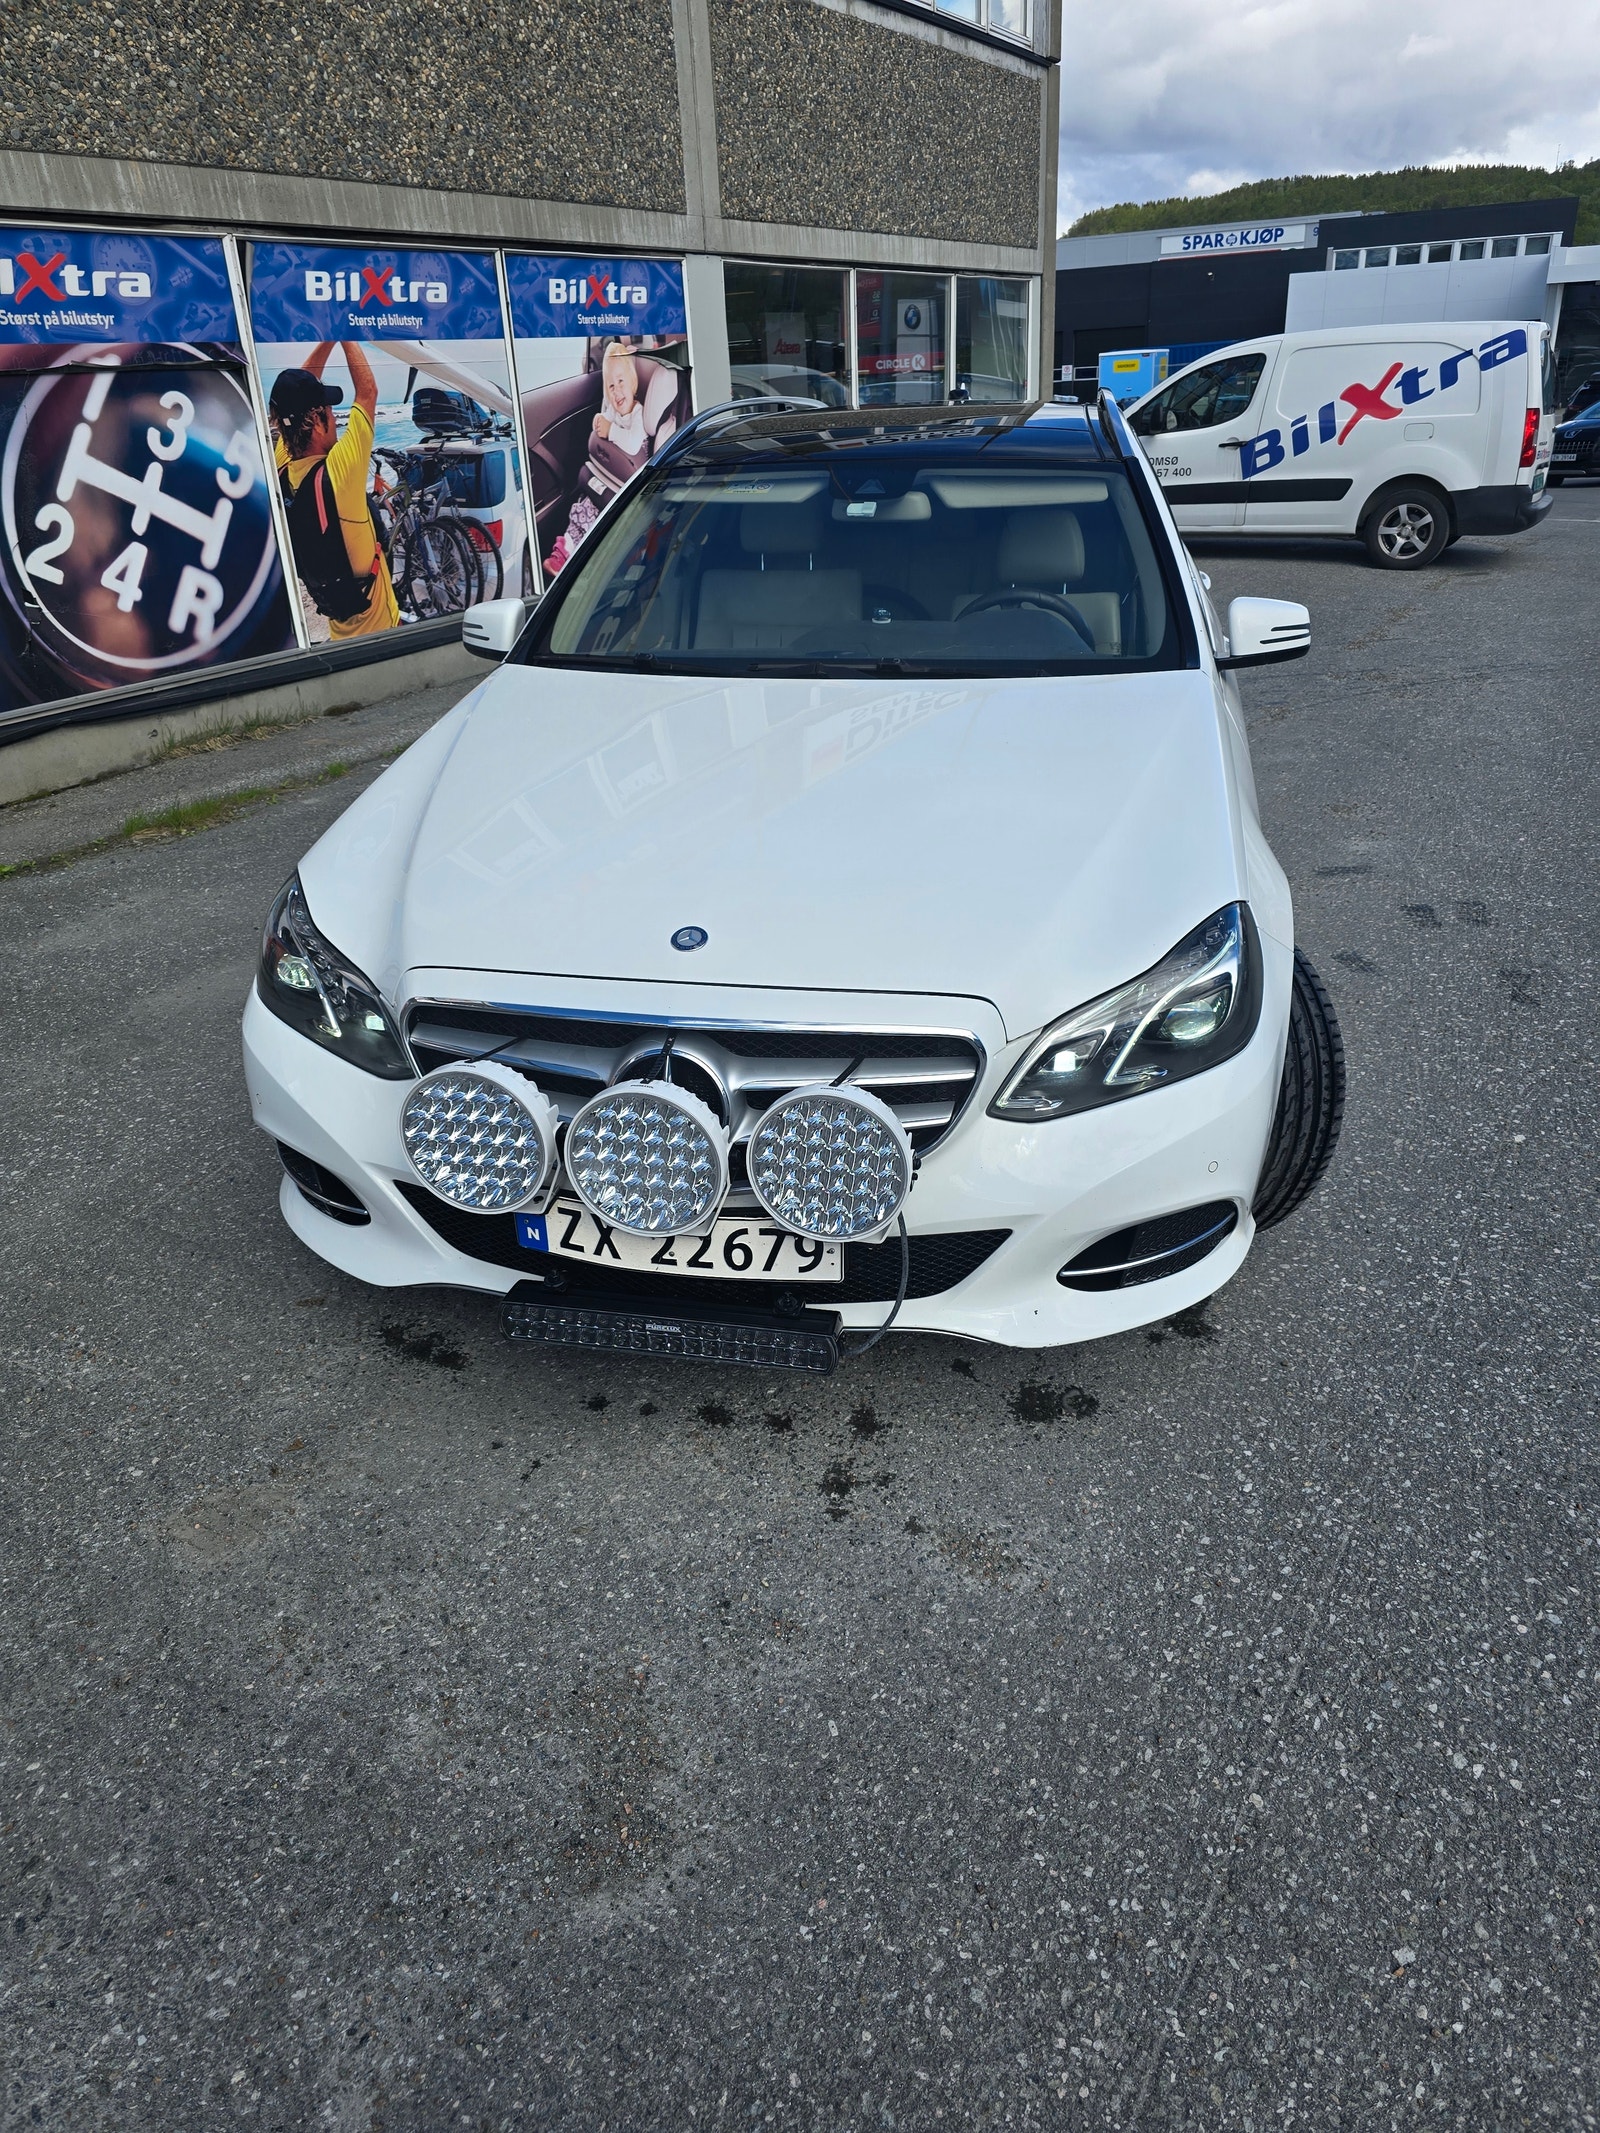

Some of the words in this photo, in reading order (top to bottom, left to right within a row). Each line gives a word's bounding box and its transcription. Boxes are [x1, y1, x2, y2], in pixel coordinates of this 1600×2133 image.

[1182, 232, 1225, 251] SPAR
[1240, 227, 1285, 246] KJØP
[0, 252, 152, 305] lXtra
[305, 266, 448, 308] BilXtra
[548, 273, 647, 308] BilXtra
[0, 309, 41, 326] Størst
[43, 310, 60, 330] på
[60, 310, 115, 329] bilutstyr
[348, 313, 376, 326] Størst
[377, 314, 388, 329] på
[388, 313, 423, 329] bilutstyr
[577, 314, 597, 325] Størst
[598, 314, 605, 327] på
[604, 314, 630, 326] bilutstyr
[875, 358, 910, 370] CIRCLE
[912, 354, 925, 370] K
[1239, 328, 1529, 480] BilXtra
[147, 390, 195, 461] 3
[216, 430, 257, 499] 5
[1149, 456, 1178, 466] OMSØ
[1172, 467, 1192, 477] 400
[25, 502, 75, 586] 2
[100, 540, 148, 613] 4
[168, 564, 224, 643] R
[527, 1227, 541, 1241] N
[557, 1206, 622, 1260] ZX
[650, 1227, 826, 1273] 22679
